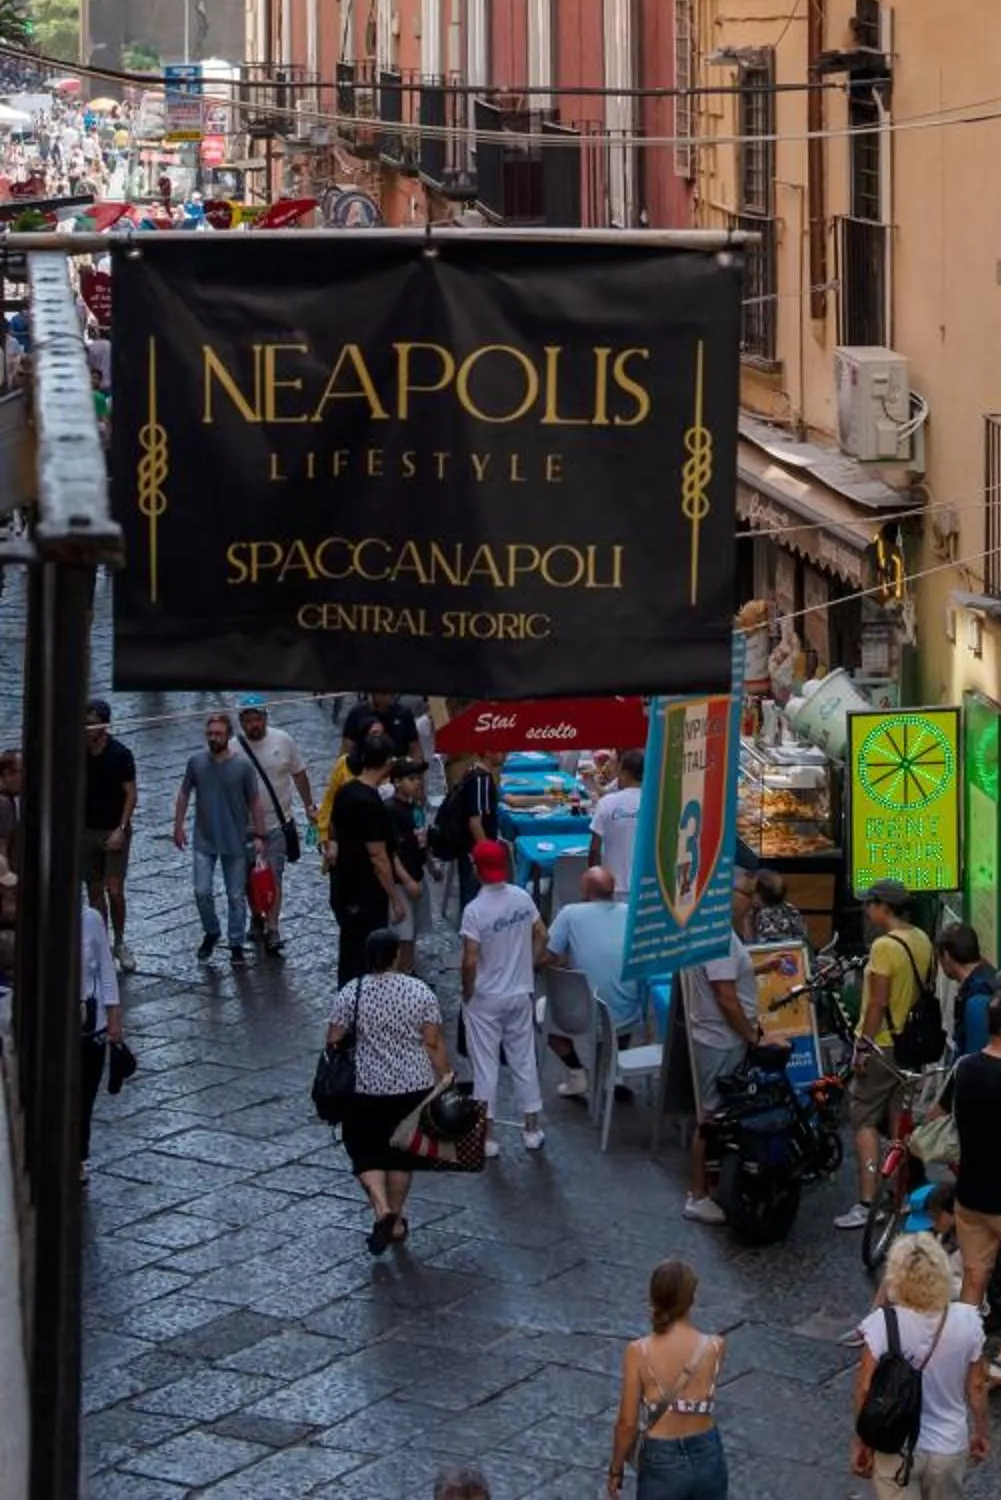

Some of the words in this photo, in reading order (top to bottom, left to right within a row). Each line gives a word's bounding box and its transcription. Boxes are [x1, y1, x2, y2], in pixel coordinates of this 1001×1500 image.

[202, 343, 651, 426] NEAPOLIS
[270, 449, 563, 481] LIFESTYLE
[226, 537, 624, 588] SPACCANAPOLI
[297, 603, 432, 637] CENTRAL
[442, 611, 551, 640] STORIC
[474, 713, 517, 732] Stai
[526, 721, 578, 740] sciolto
[865, 841, 944, 863] TOUR
